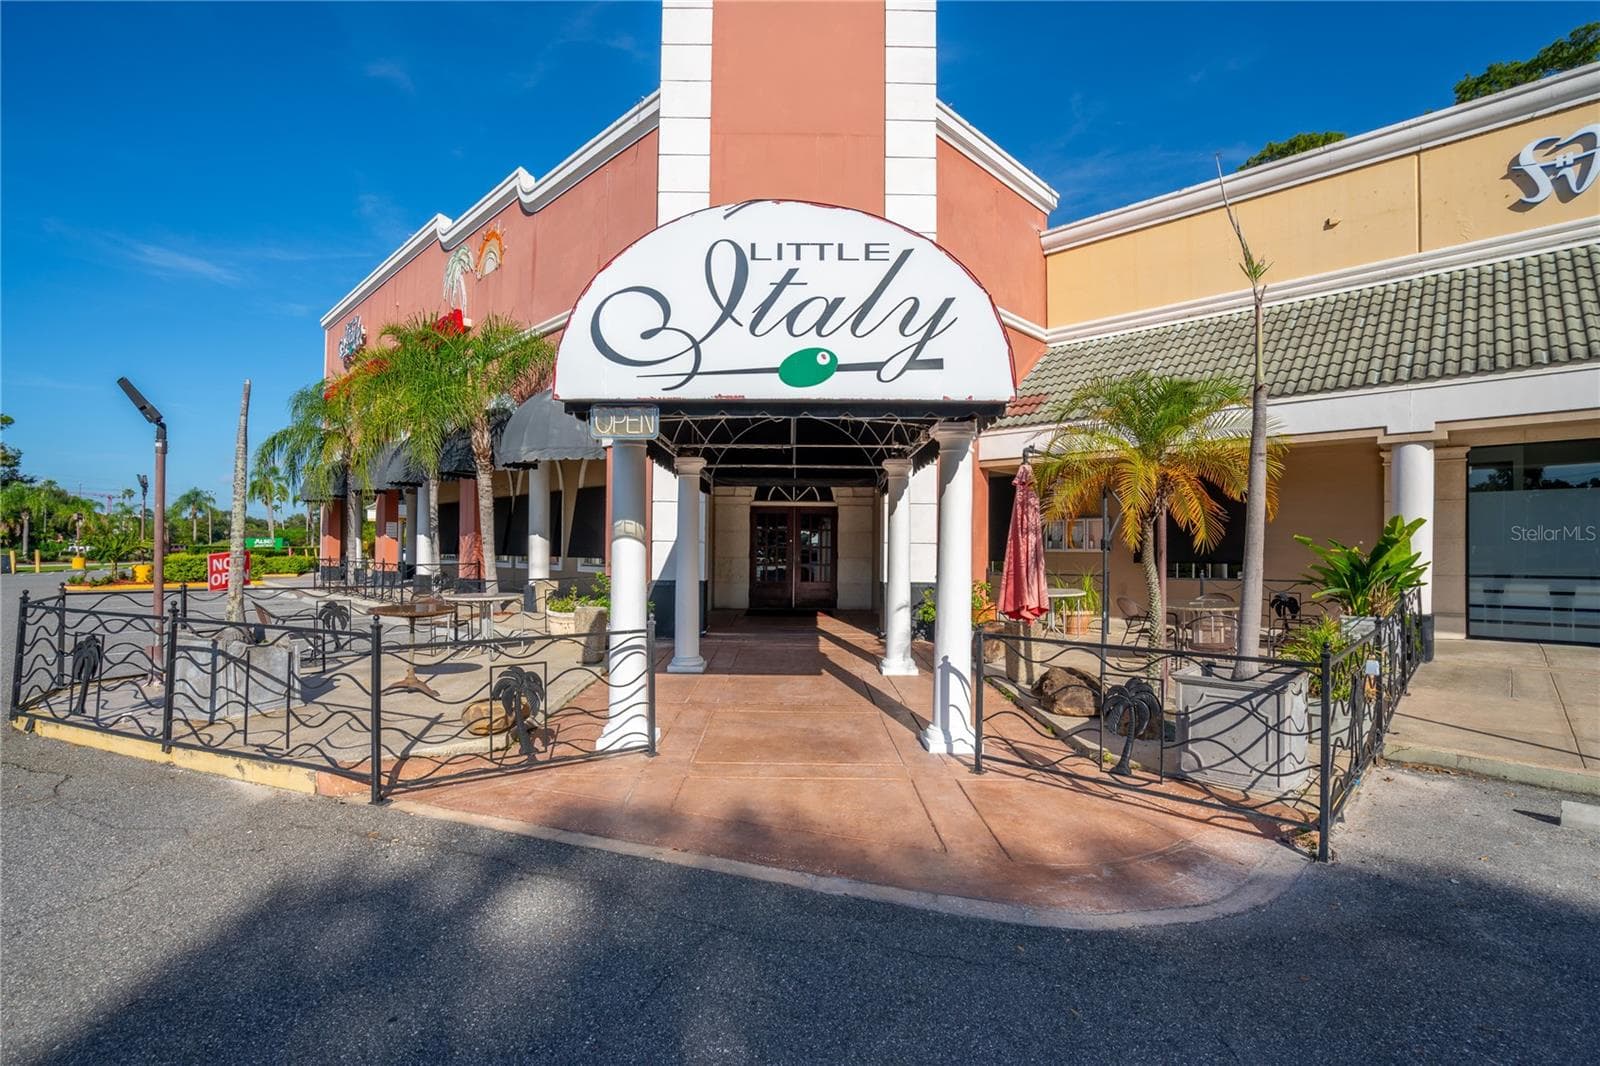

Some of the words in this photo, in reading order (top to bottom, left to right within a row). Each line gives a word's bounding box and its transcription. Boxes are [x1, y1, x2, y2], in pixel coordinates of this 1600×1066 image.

[749, 242, 891, 262] LITTLE
[590, 238, 959, 391] Italy
[594, 410, 655, 434] OPEN
